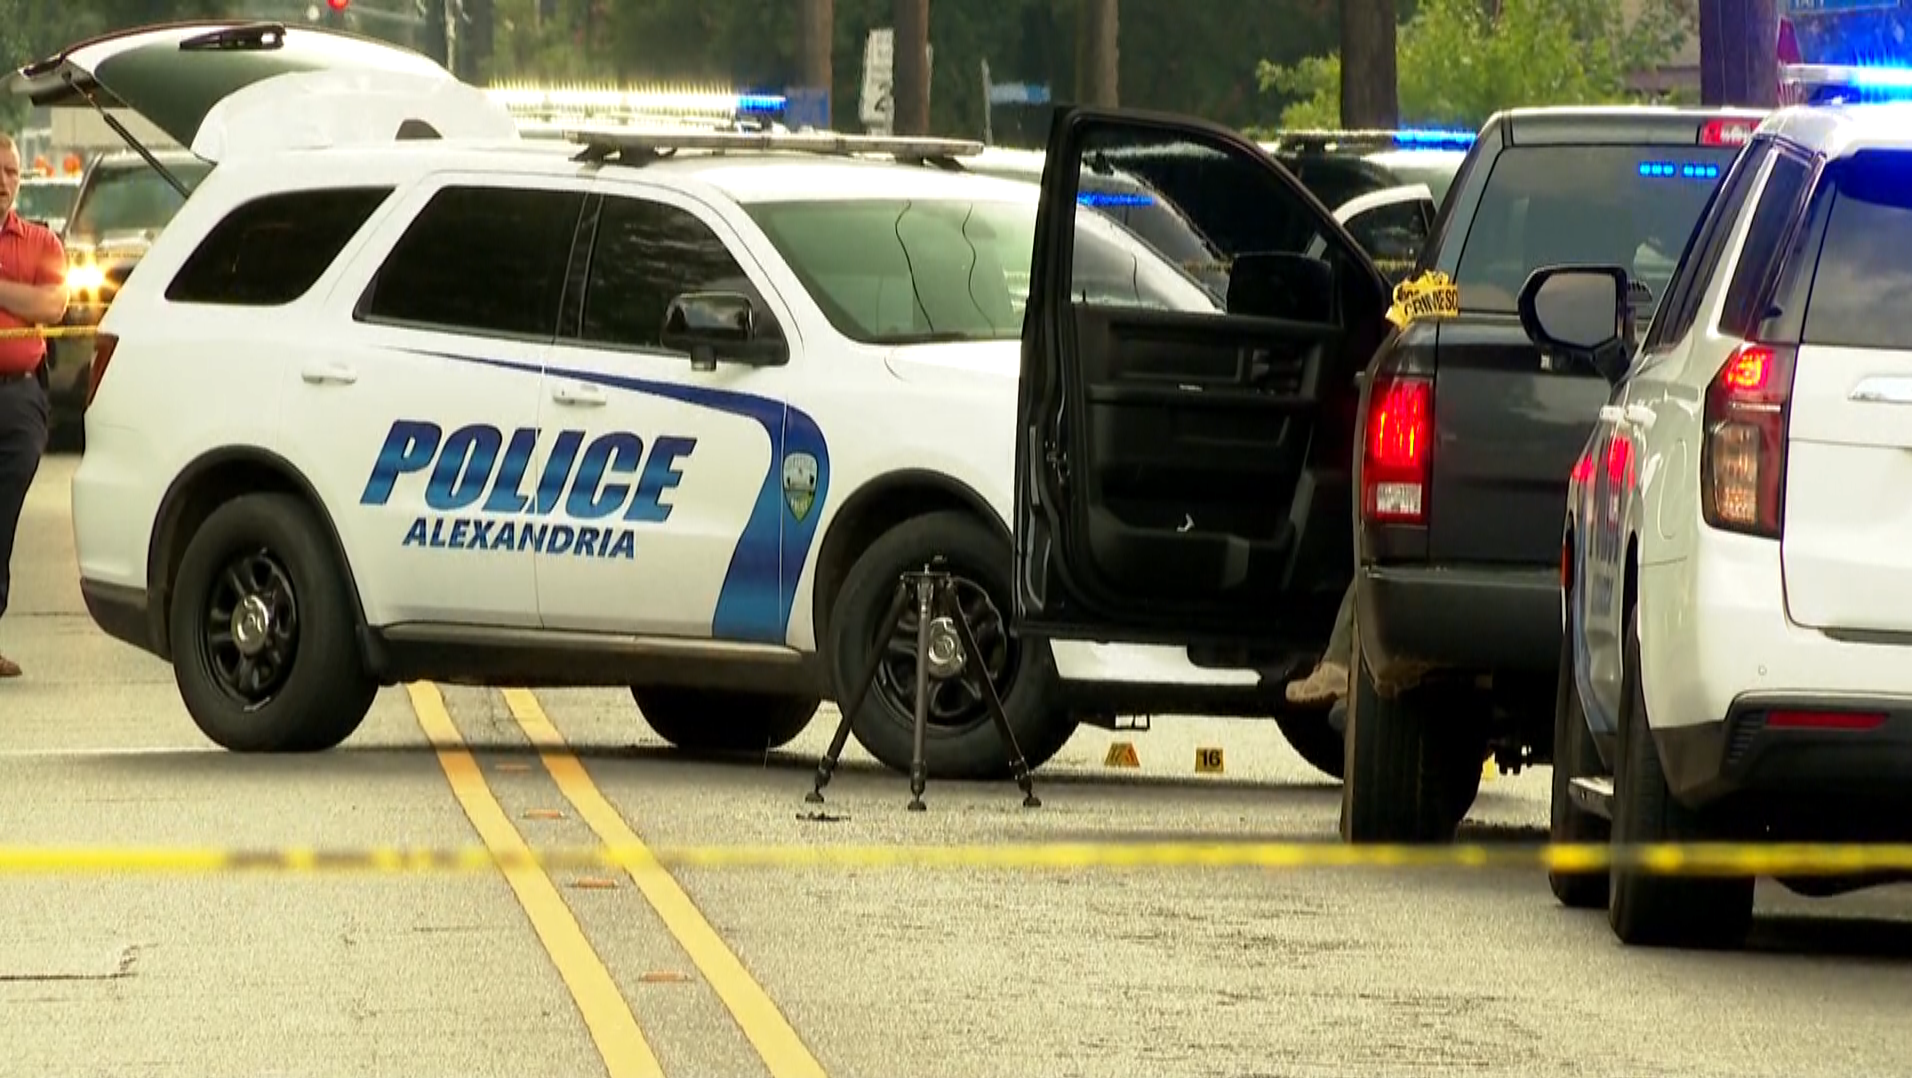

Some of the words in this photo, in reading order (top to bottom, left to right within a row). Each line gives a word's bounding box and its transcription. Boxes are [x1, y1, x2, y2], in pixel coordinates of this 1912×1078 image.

[359, 418, 698, 523] POLICE
[401, 517, 636, 560] ALEXANDRIA
[1203, 749, 1221, 767] 16
